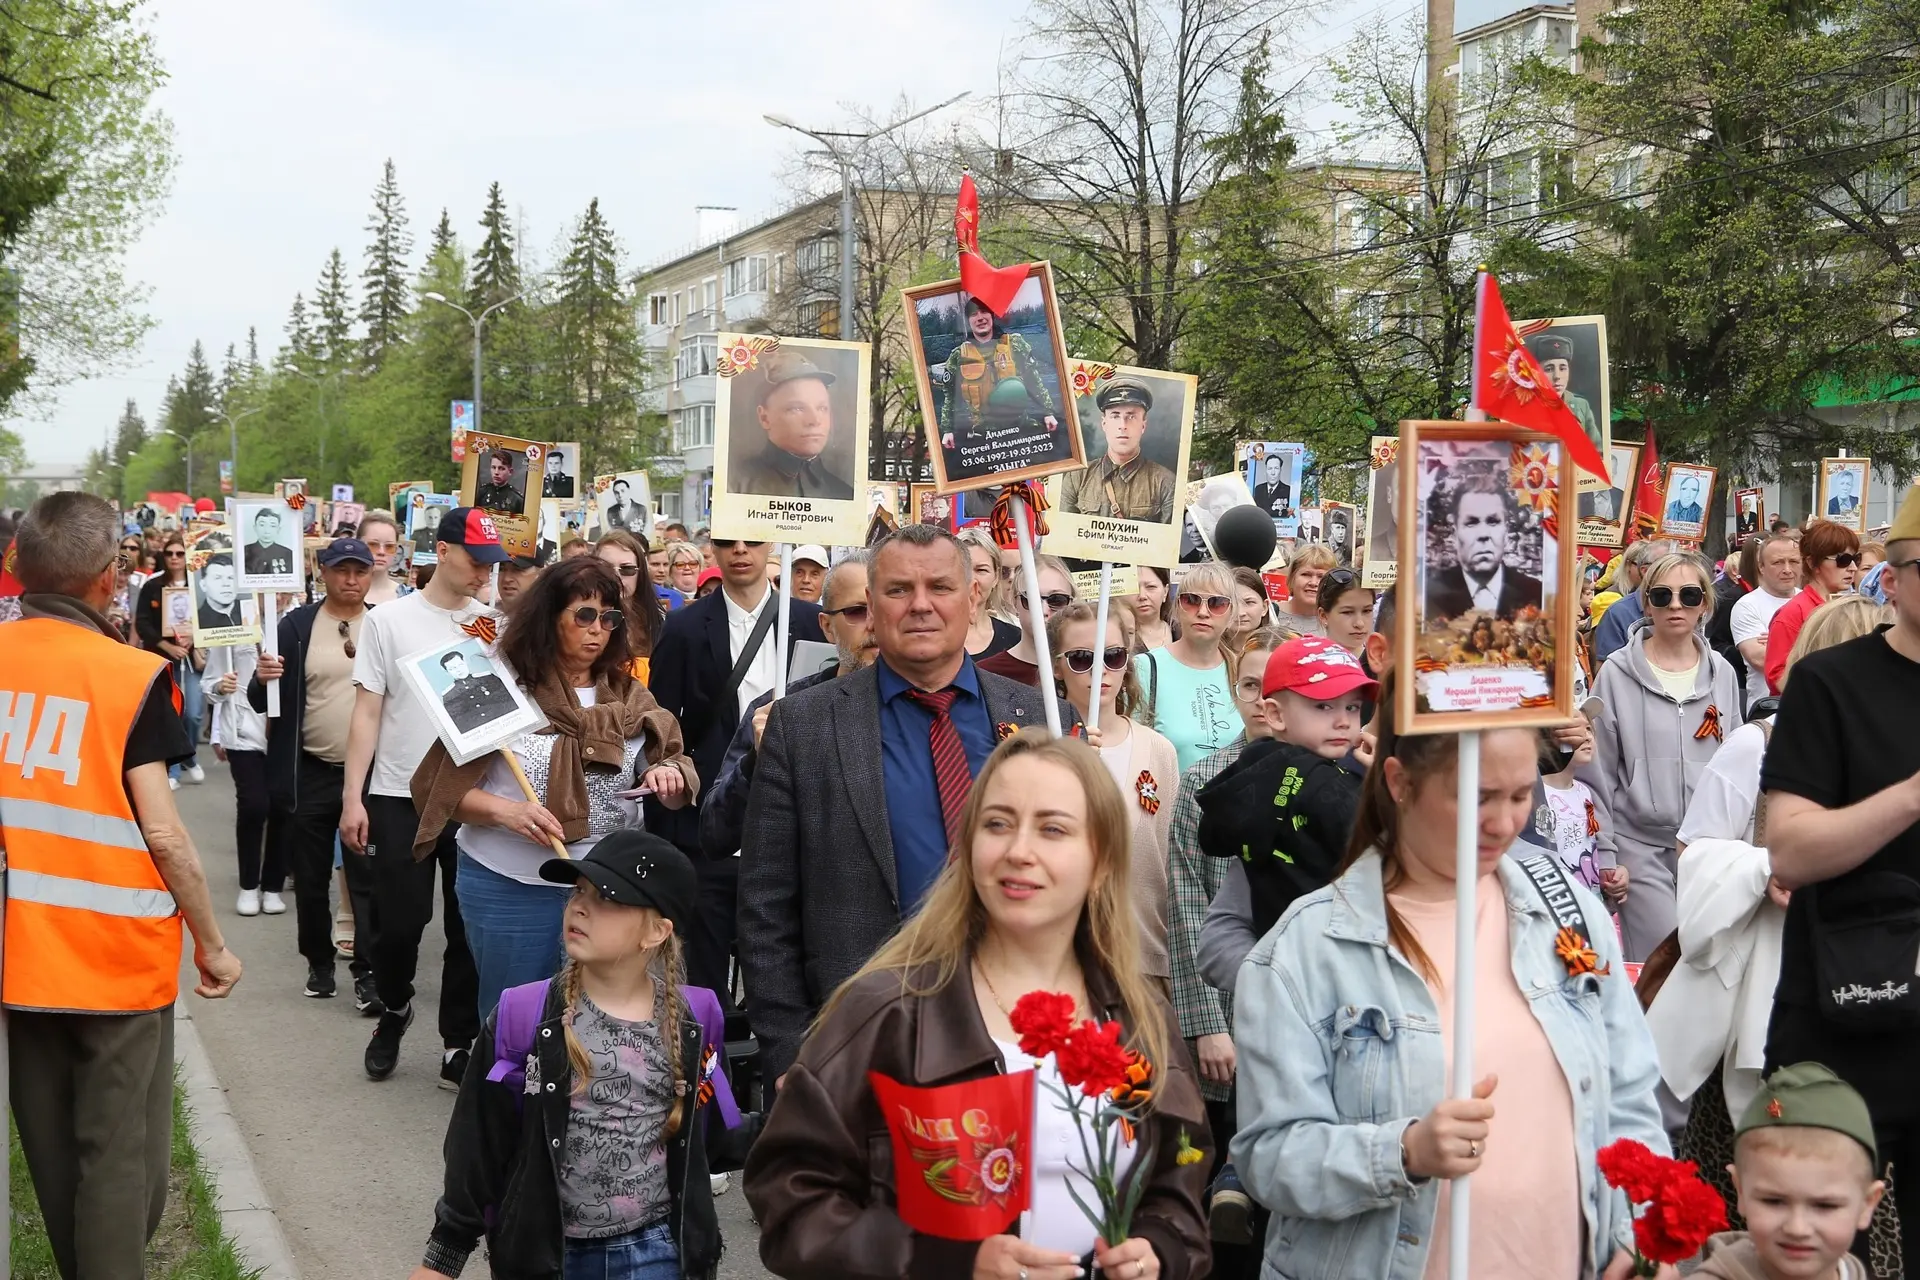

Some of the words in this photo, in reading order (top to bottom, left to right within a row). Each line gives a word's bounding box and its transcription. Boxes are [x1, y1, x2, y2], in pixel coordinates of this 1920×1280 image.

[985, 426, 1020, 440] Диденко
[960, 443, 990, 456] Сергей
[991, 433, 1051, 450] Владимирович
[961, 442, 1054, 467] 03.06.1992-19.03.2023
[769, 500, 812, 512] БЫКОВ
[747, 509, 779, 520] Игнат
[782, 511, 834, 523] Петрович
[1091, 520, 1139, 534] ПОЛУХИН
[1077, 528, 1105, 539] Ефим
[1107, 532, 1149, 544] Кузьмич
